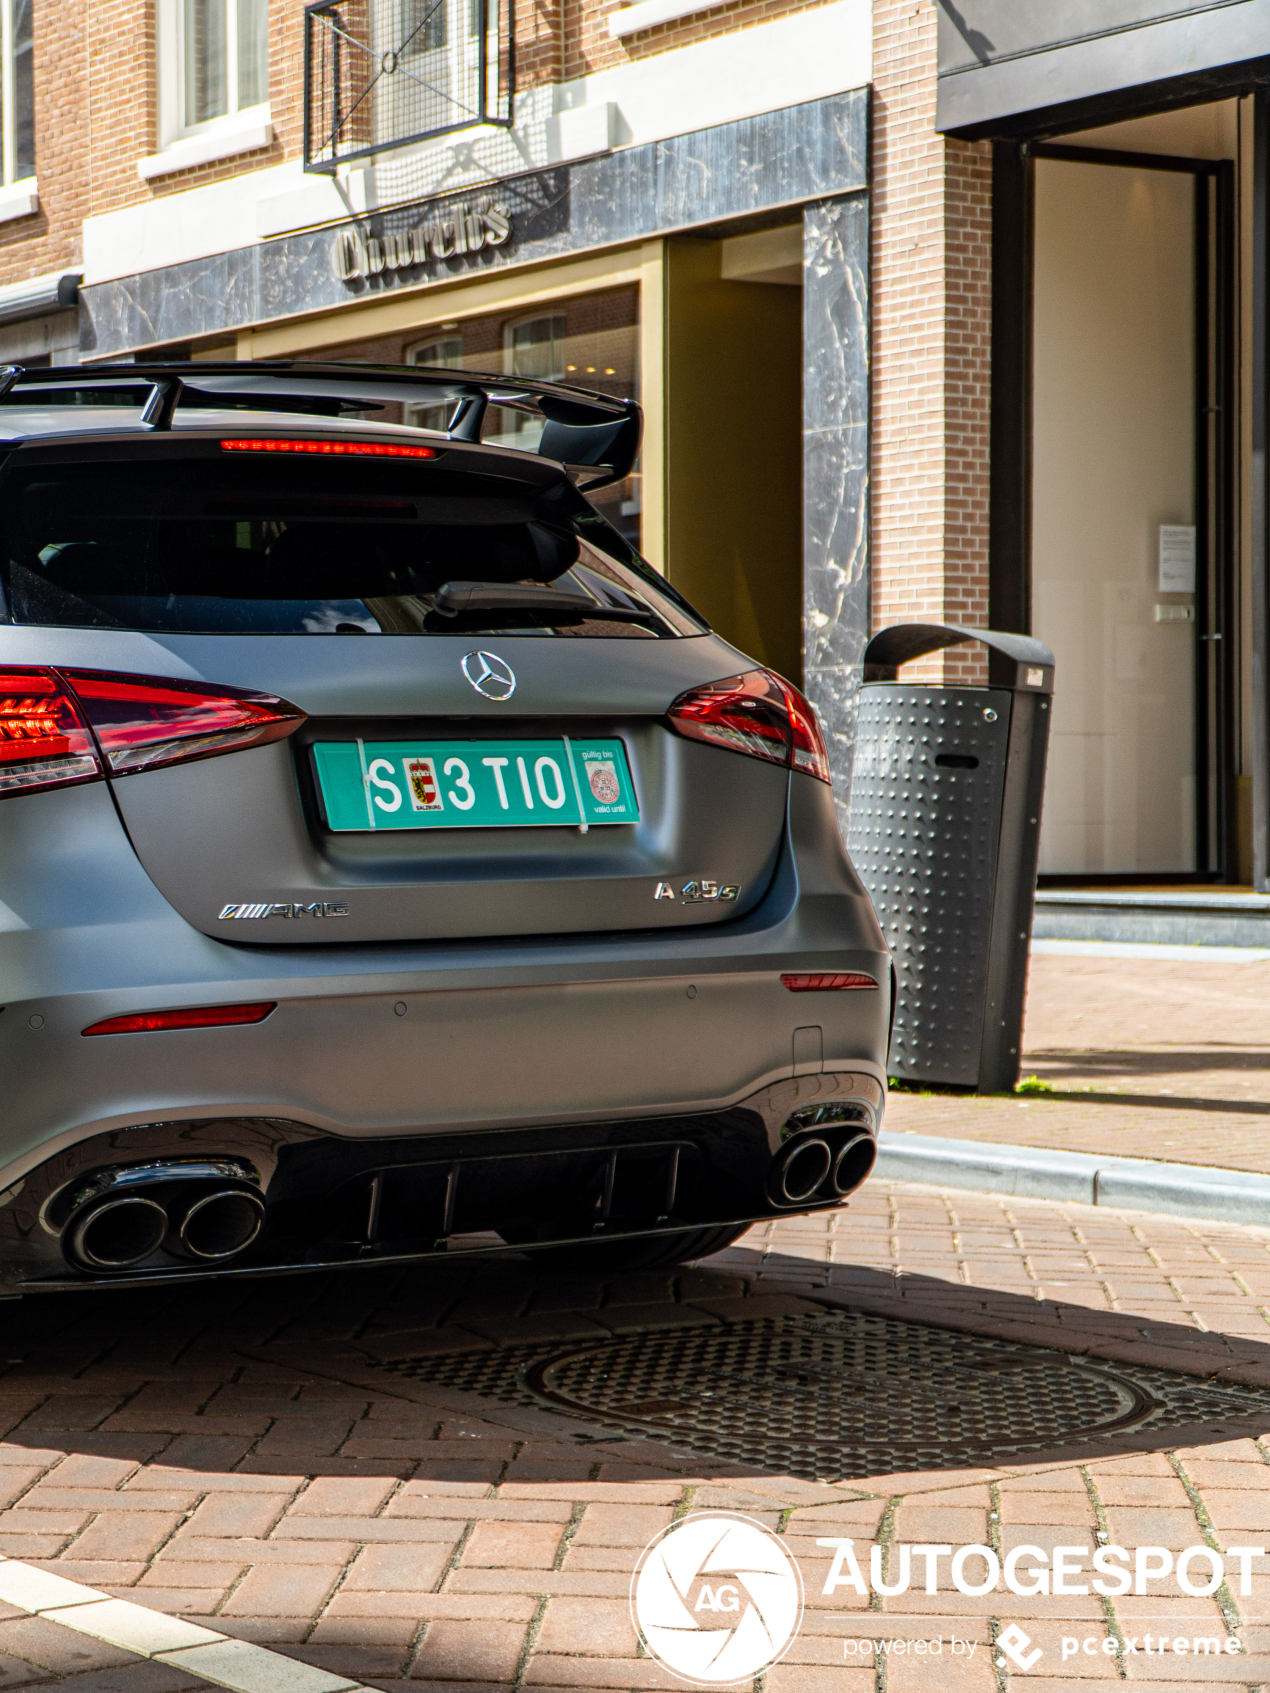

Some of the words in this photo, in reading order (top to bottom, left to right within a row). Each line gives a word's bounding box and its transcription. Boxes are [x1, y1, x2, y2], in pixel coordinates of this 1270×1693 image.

[333, 196, 512, 280] Church's
[582, 750, 602, 760] gültig
[602, 750, 614, 758] bis
[368, 759, 402, 813] S
[594, 805, 610, 813] valid
[611, 805, 627, 813] until
[654, 882, 675, 899] A
[260, 901, 350, 919] AMG
